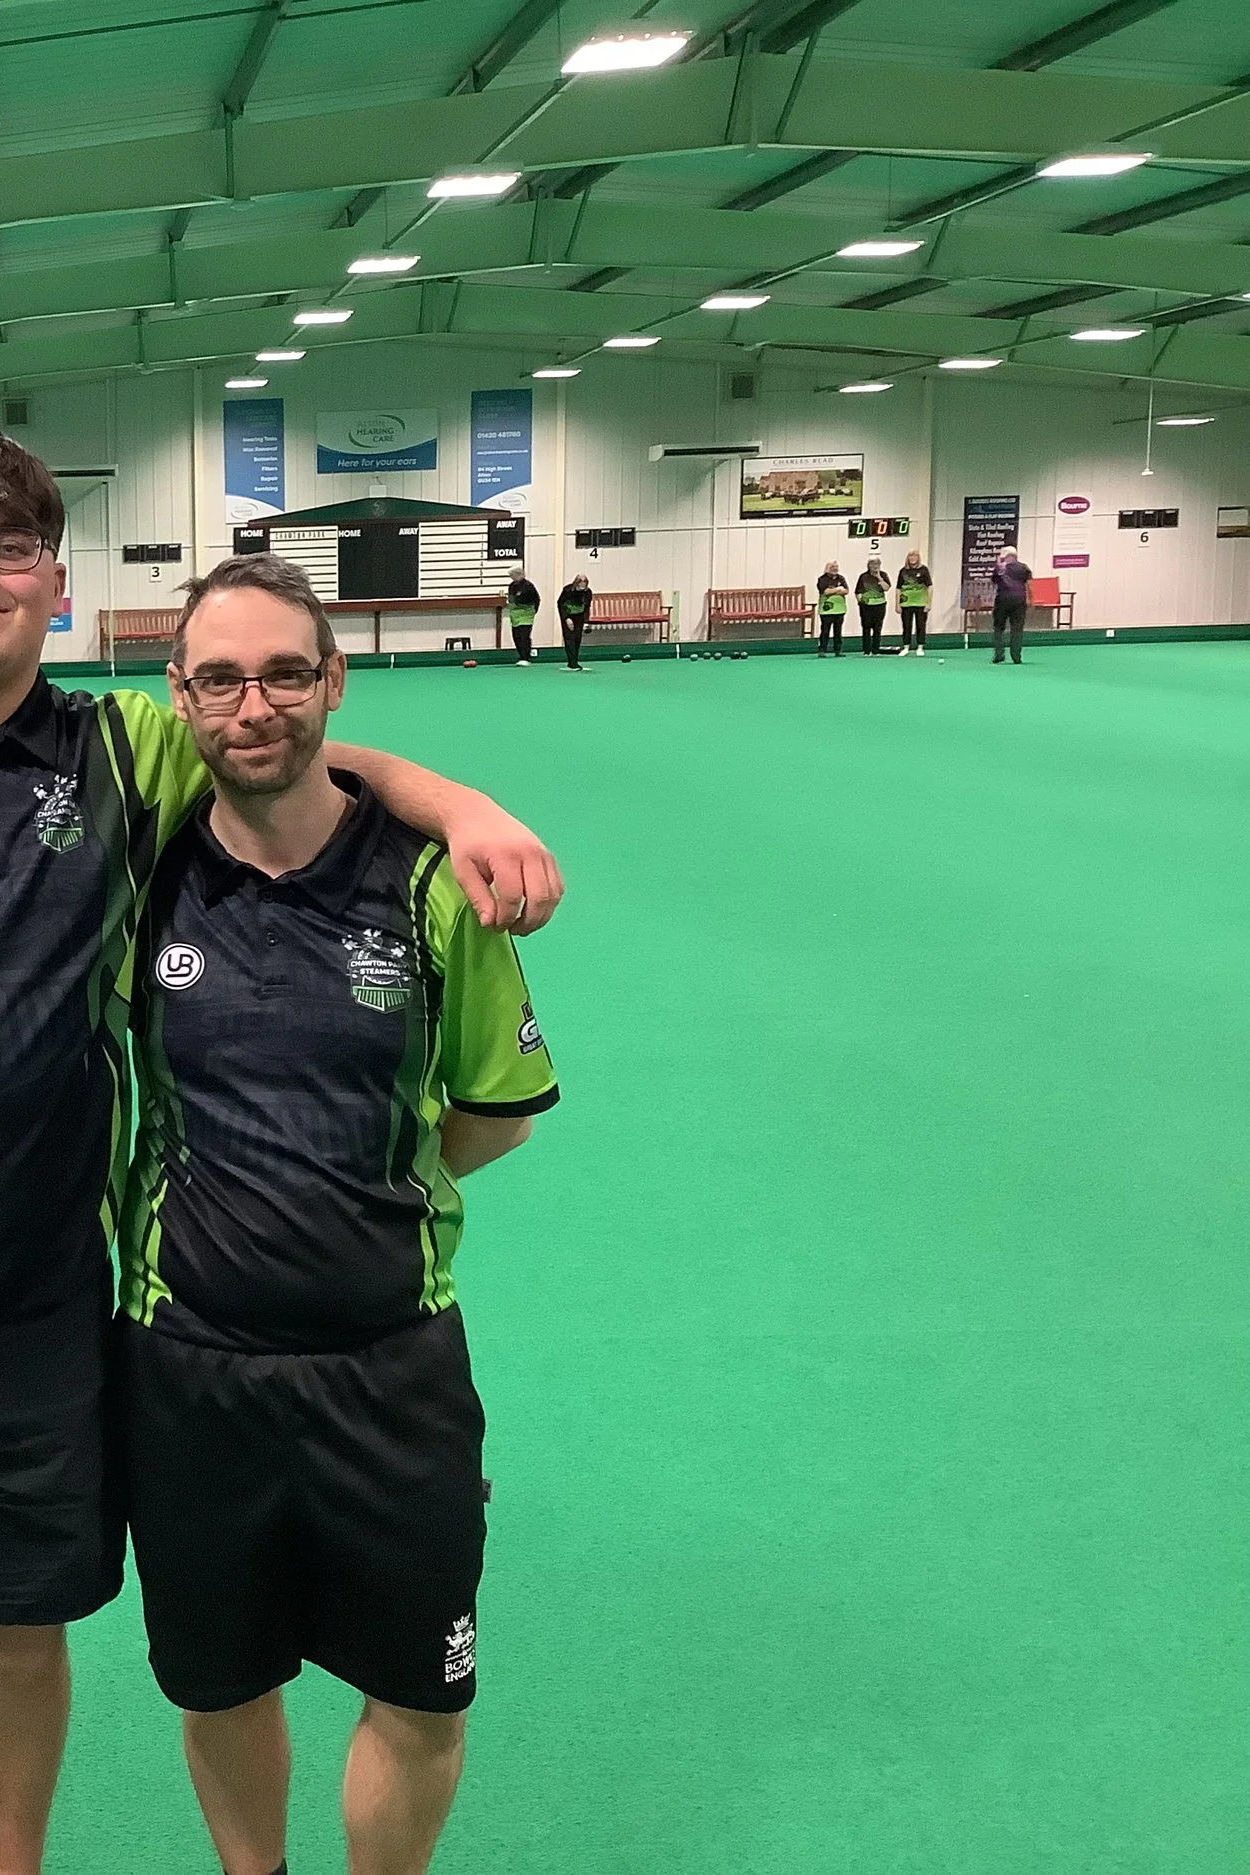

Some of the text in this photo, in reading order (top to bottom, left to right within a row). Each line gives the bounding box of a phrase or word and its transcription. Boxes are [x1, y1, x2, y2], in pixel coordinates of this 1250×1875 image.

[356, 427, 395, 436] HEARING
[337, 459, 359, 467] Here
[361, 458, 374, 467] for
[375, 459, 397, 468] your
[496, 520, 517, 528] AWAY
[856, 520, 909, 535] 0 0 0
[240, 529, 264, 538] HOME
[338, 529, 361, 537] HOME
[398, 528, 418, 536] AWAY
[1140, 531, 1149, 543] 6
[870, 538, 880, 550] 5
[494, 548, 518, 557] TOTAL
[589, 548, 599, 559] 4
[151, 566, 160, 578] 3
[350, 960, 388, 968] CHAWTON
[359, 967, 401, 976] STEAMERS
